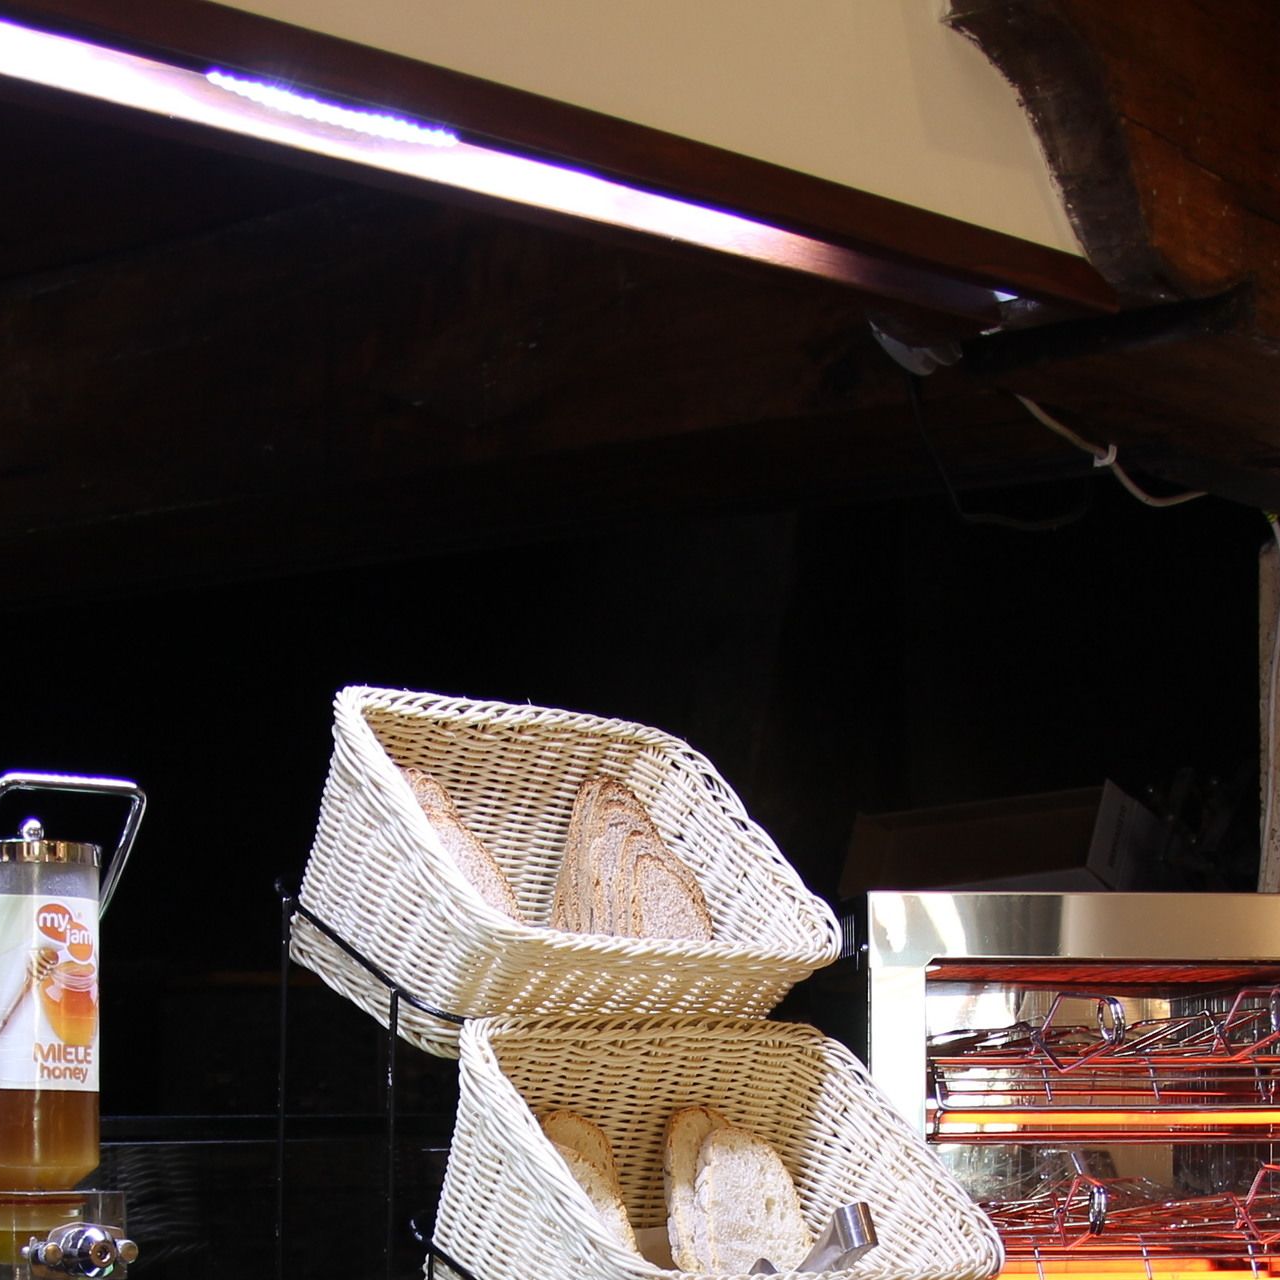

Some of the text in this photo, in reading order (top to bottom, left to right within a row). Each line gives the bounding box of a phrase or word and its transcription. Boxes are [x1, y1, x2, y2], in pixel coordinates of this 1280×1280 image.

[39, 912, 92, 946] my jam
[33, 1042, 93, 1065] MIELE
[39, 1062, 89, 1084] honey
